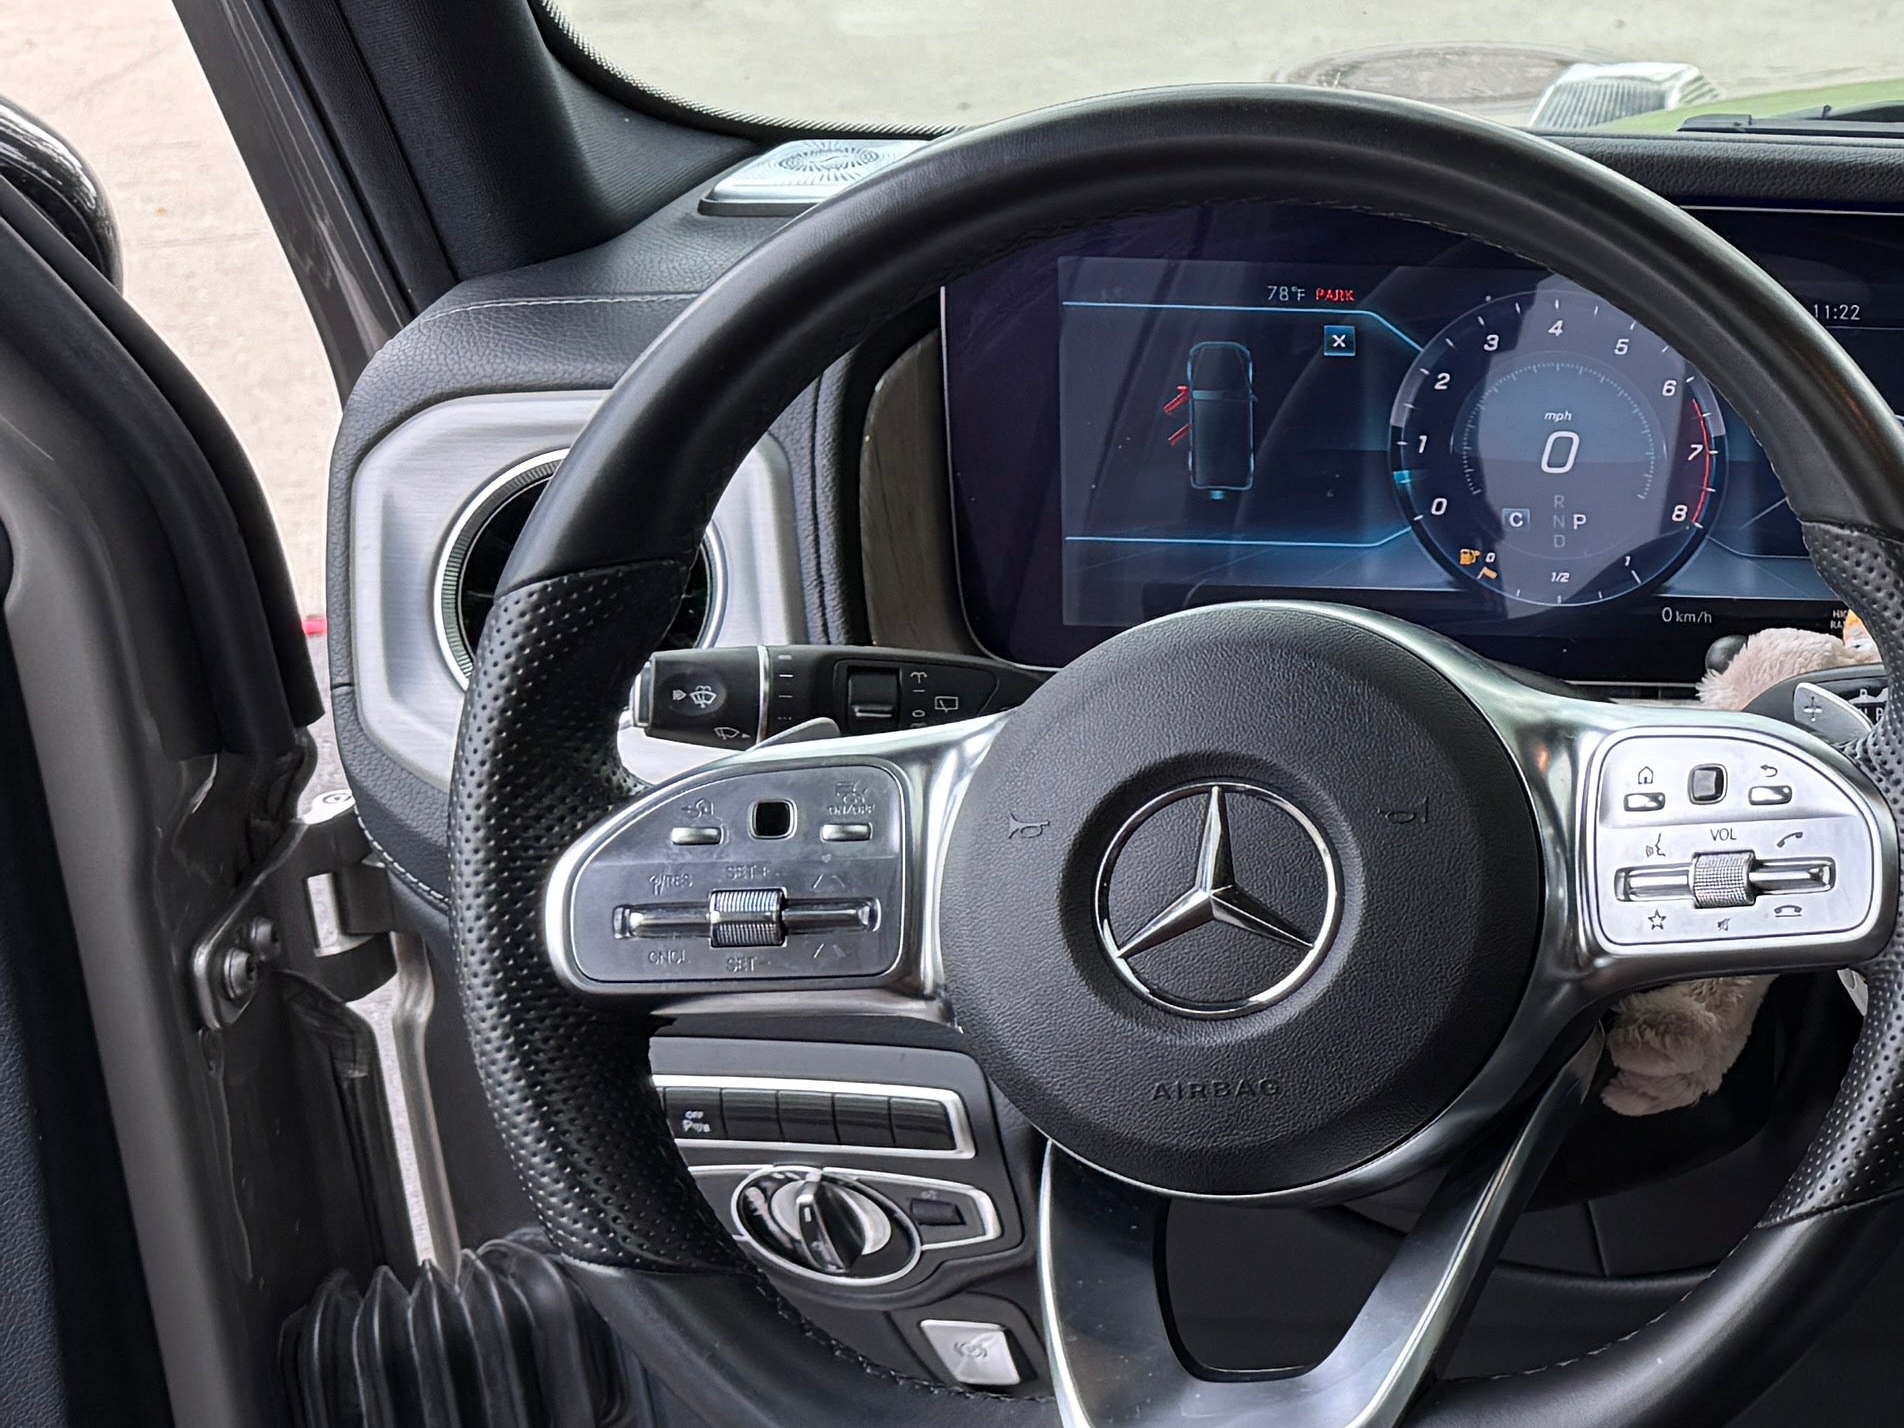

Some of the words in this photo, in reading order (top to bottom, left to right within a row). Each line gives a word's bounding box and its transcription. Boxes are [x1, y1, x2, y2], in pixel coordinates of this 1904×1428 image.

[1267, 285, 1306, 301] 78°F
[1315, 287, 1355, 301] PARK
[1813, 304, 1861, 321] 11:22
[1548, 319, 1564, 336] 4
[1484, 334, 1499, 351] 3
[1614, 338, 1630, 355] 5
[1434, 373, 1450, 390] 2
[1662, 380, 1677, 396] 6
[1544, 410, 1573, 423] mph
[1418, 435, 1428, 454] 1
[1541, 430, 1580, 475] 0
[1688, 444, 1703, 461] 7
[1431, 497, 1448, 515] 0
[1554, 494, 1565, 509] R
[1508, 511, 1524, 528] C
[1552, 514, 1566, 529] N
[1573, 514, 1587, 530] P
[1671, 505, 1688, 522] 8
[1553, 534, 1566, 548] D
[1485, 552, 1496, 563] 0
[1624, 556, 1632, 566] 1
[1551, 572, 1570, 583] 1/2
[1661, 607, 1673, 623] 0
[1675, 610, 1713, 624] km/h
[1710, 828, 1737, 841] VOL
[1152, 1078, 1280, 1101] AIRBAG
